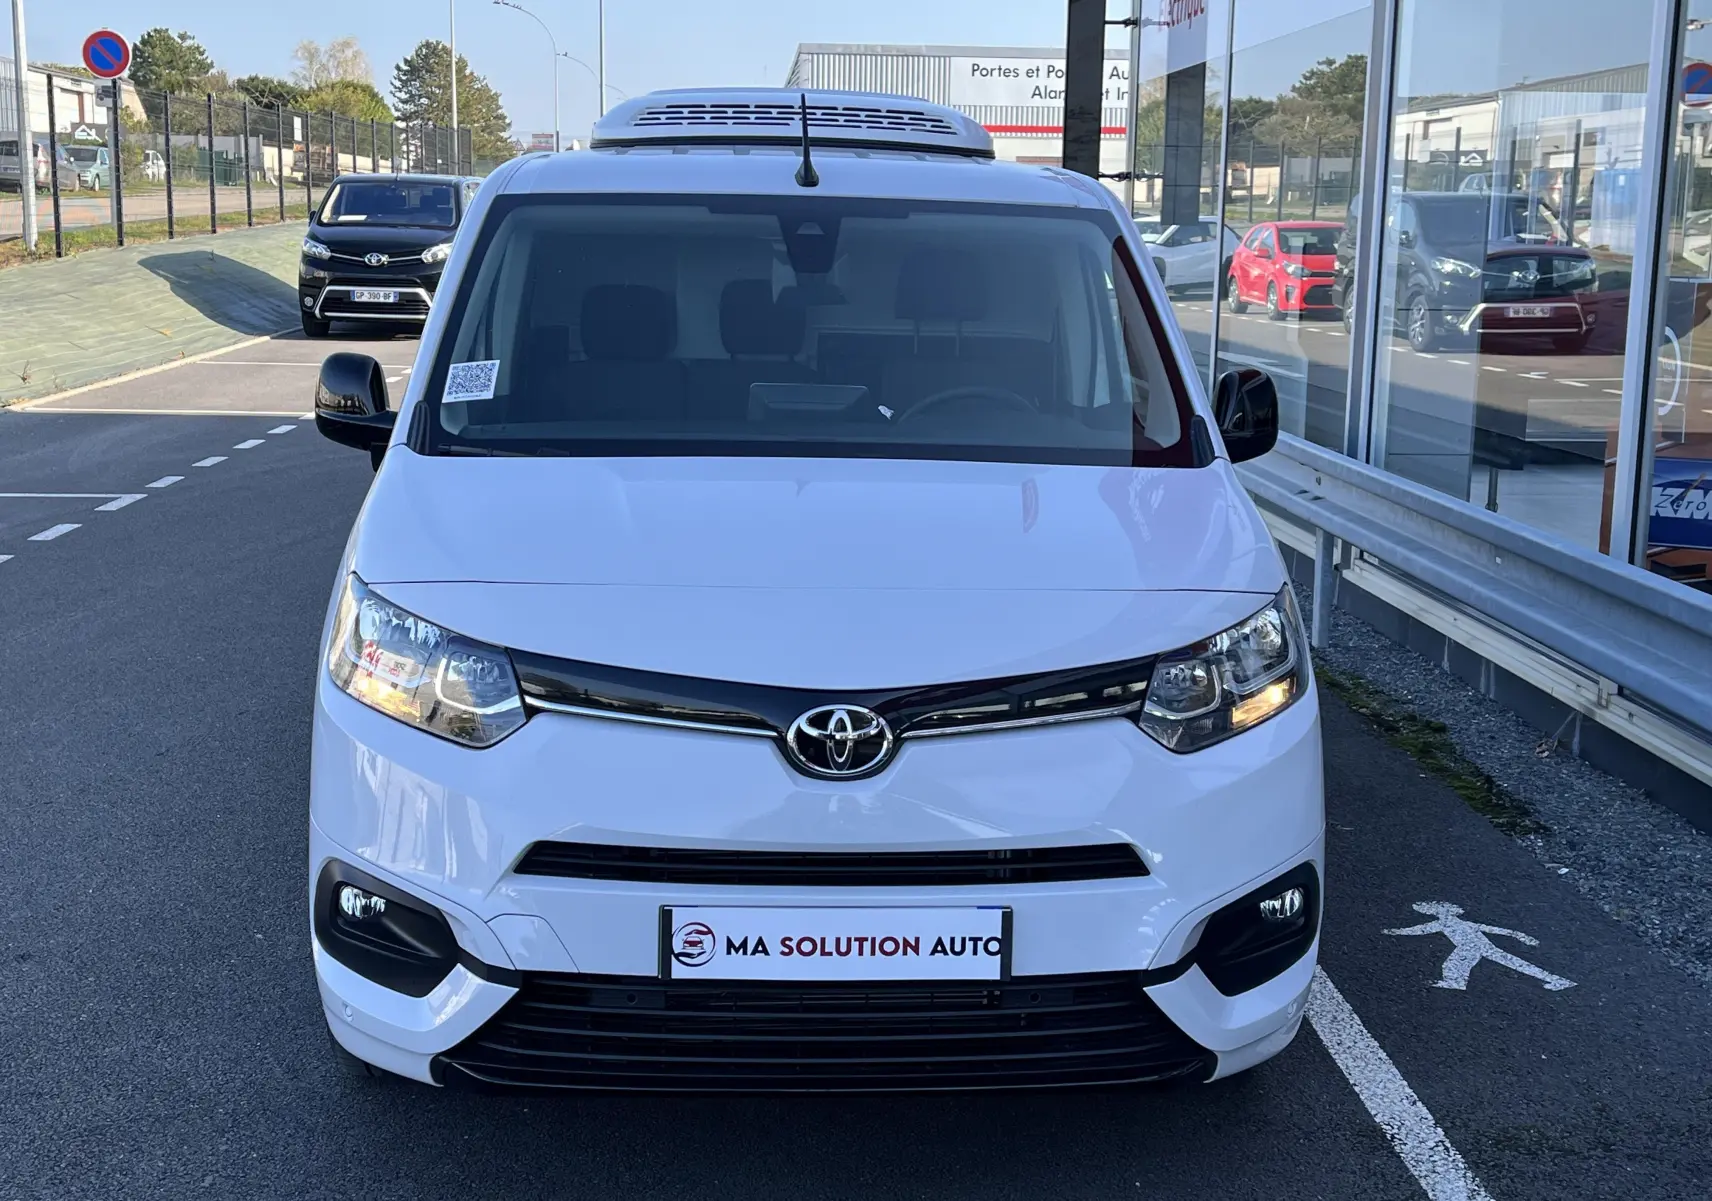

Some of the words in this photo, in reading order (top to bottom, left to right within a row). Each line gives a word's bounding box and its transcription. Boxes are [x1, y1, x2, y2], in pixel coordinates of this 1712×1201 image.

[971, 63, 1019, 78] Portes
[1025, 65, 1040, 78] et
[1031, 85, 1066, 100] Alar
[725, 935, 771, 957] MA
[779, 935, 920, 957] SOLUTION
[928, 935, 1002, 957] AUTO
